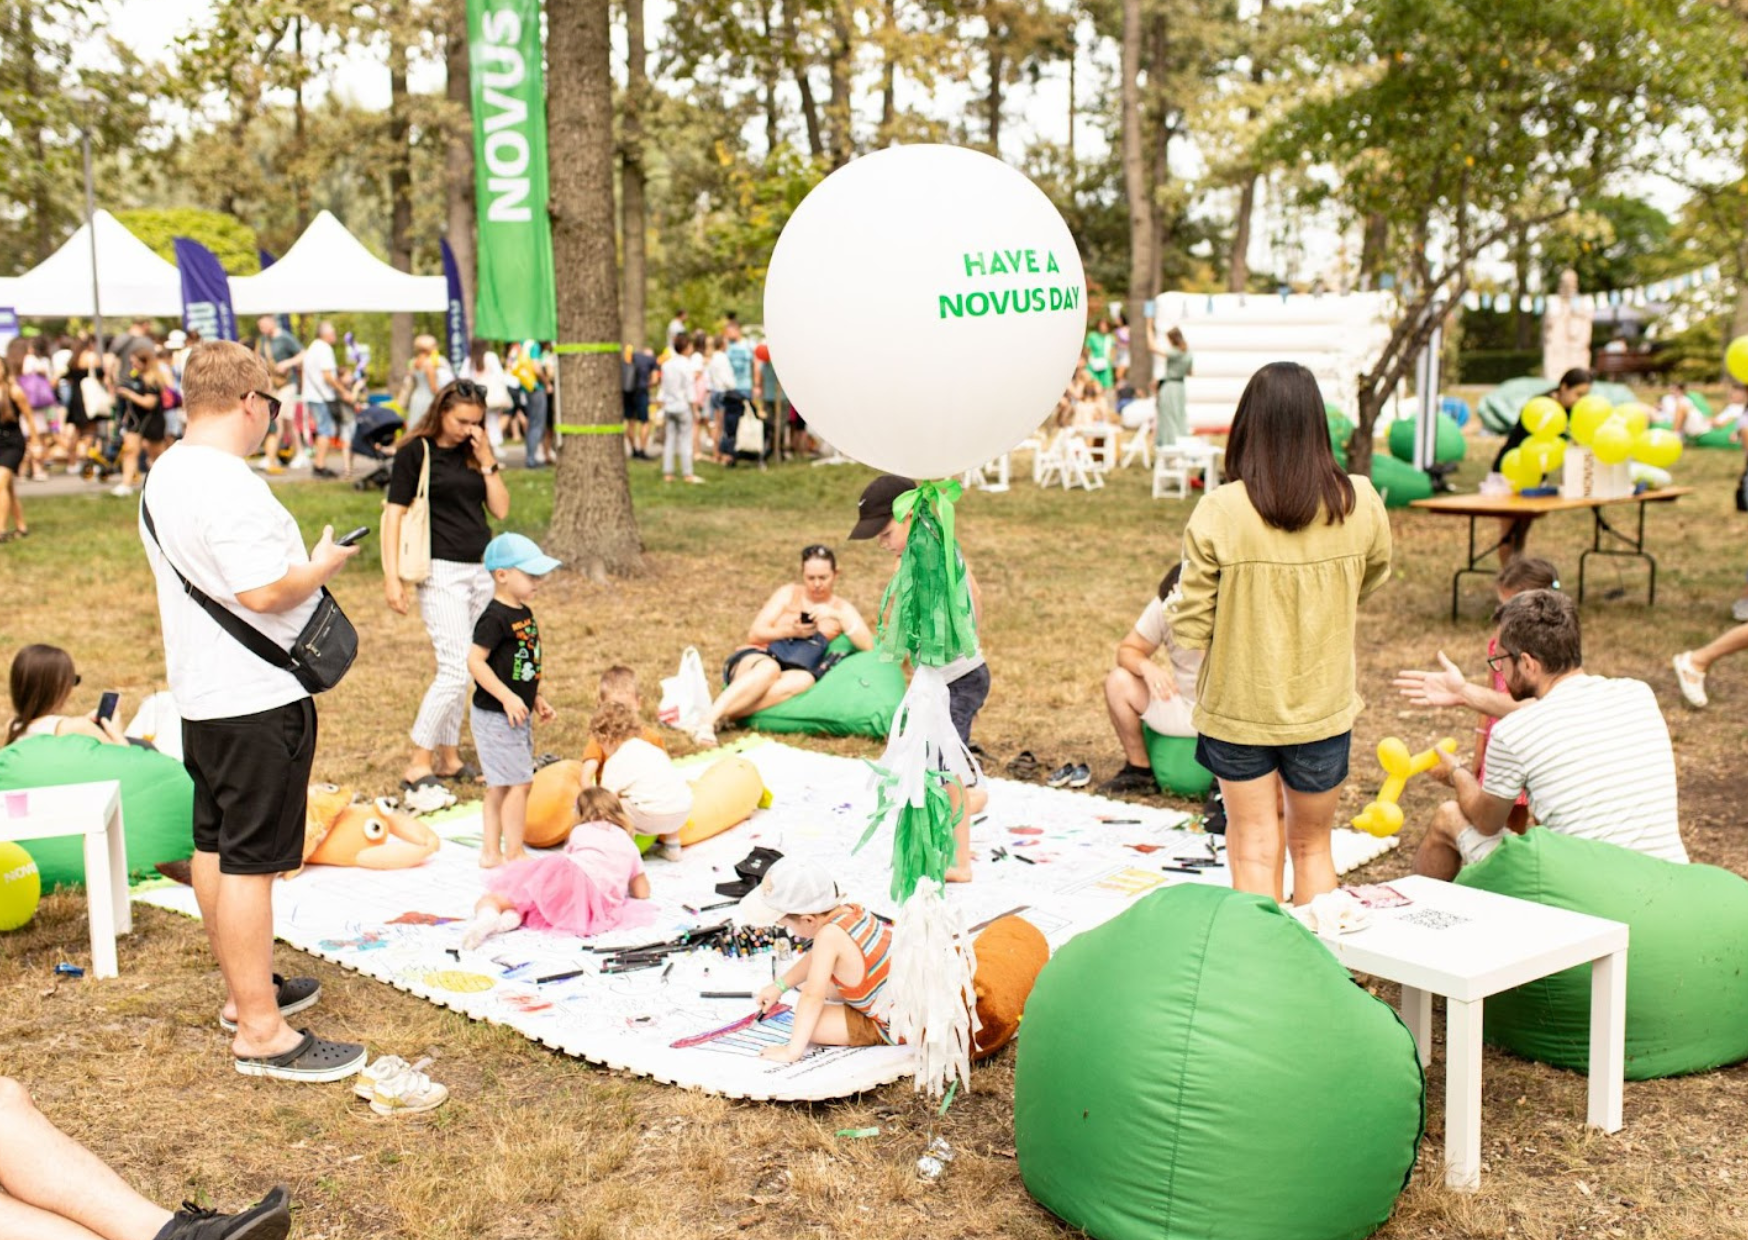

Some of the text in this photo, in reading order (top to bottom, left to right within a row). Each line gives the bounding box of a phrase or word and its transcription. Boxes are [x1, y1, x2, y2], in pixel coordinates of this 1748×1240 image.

[482, 9, 532, 222] NOVUS
[963, 249, 1060, 277] HAVE A
[939, 285, 1079, 319] NOVUS DAY
